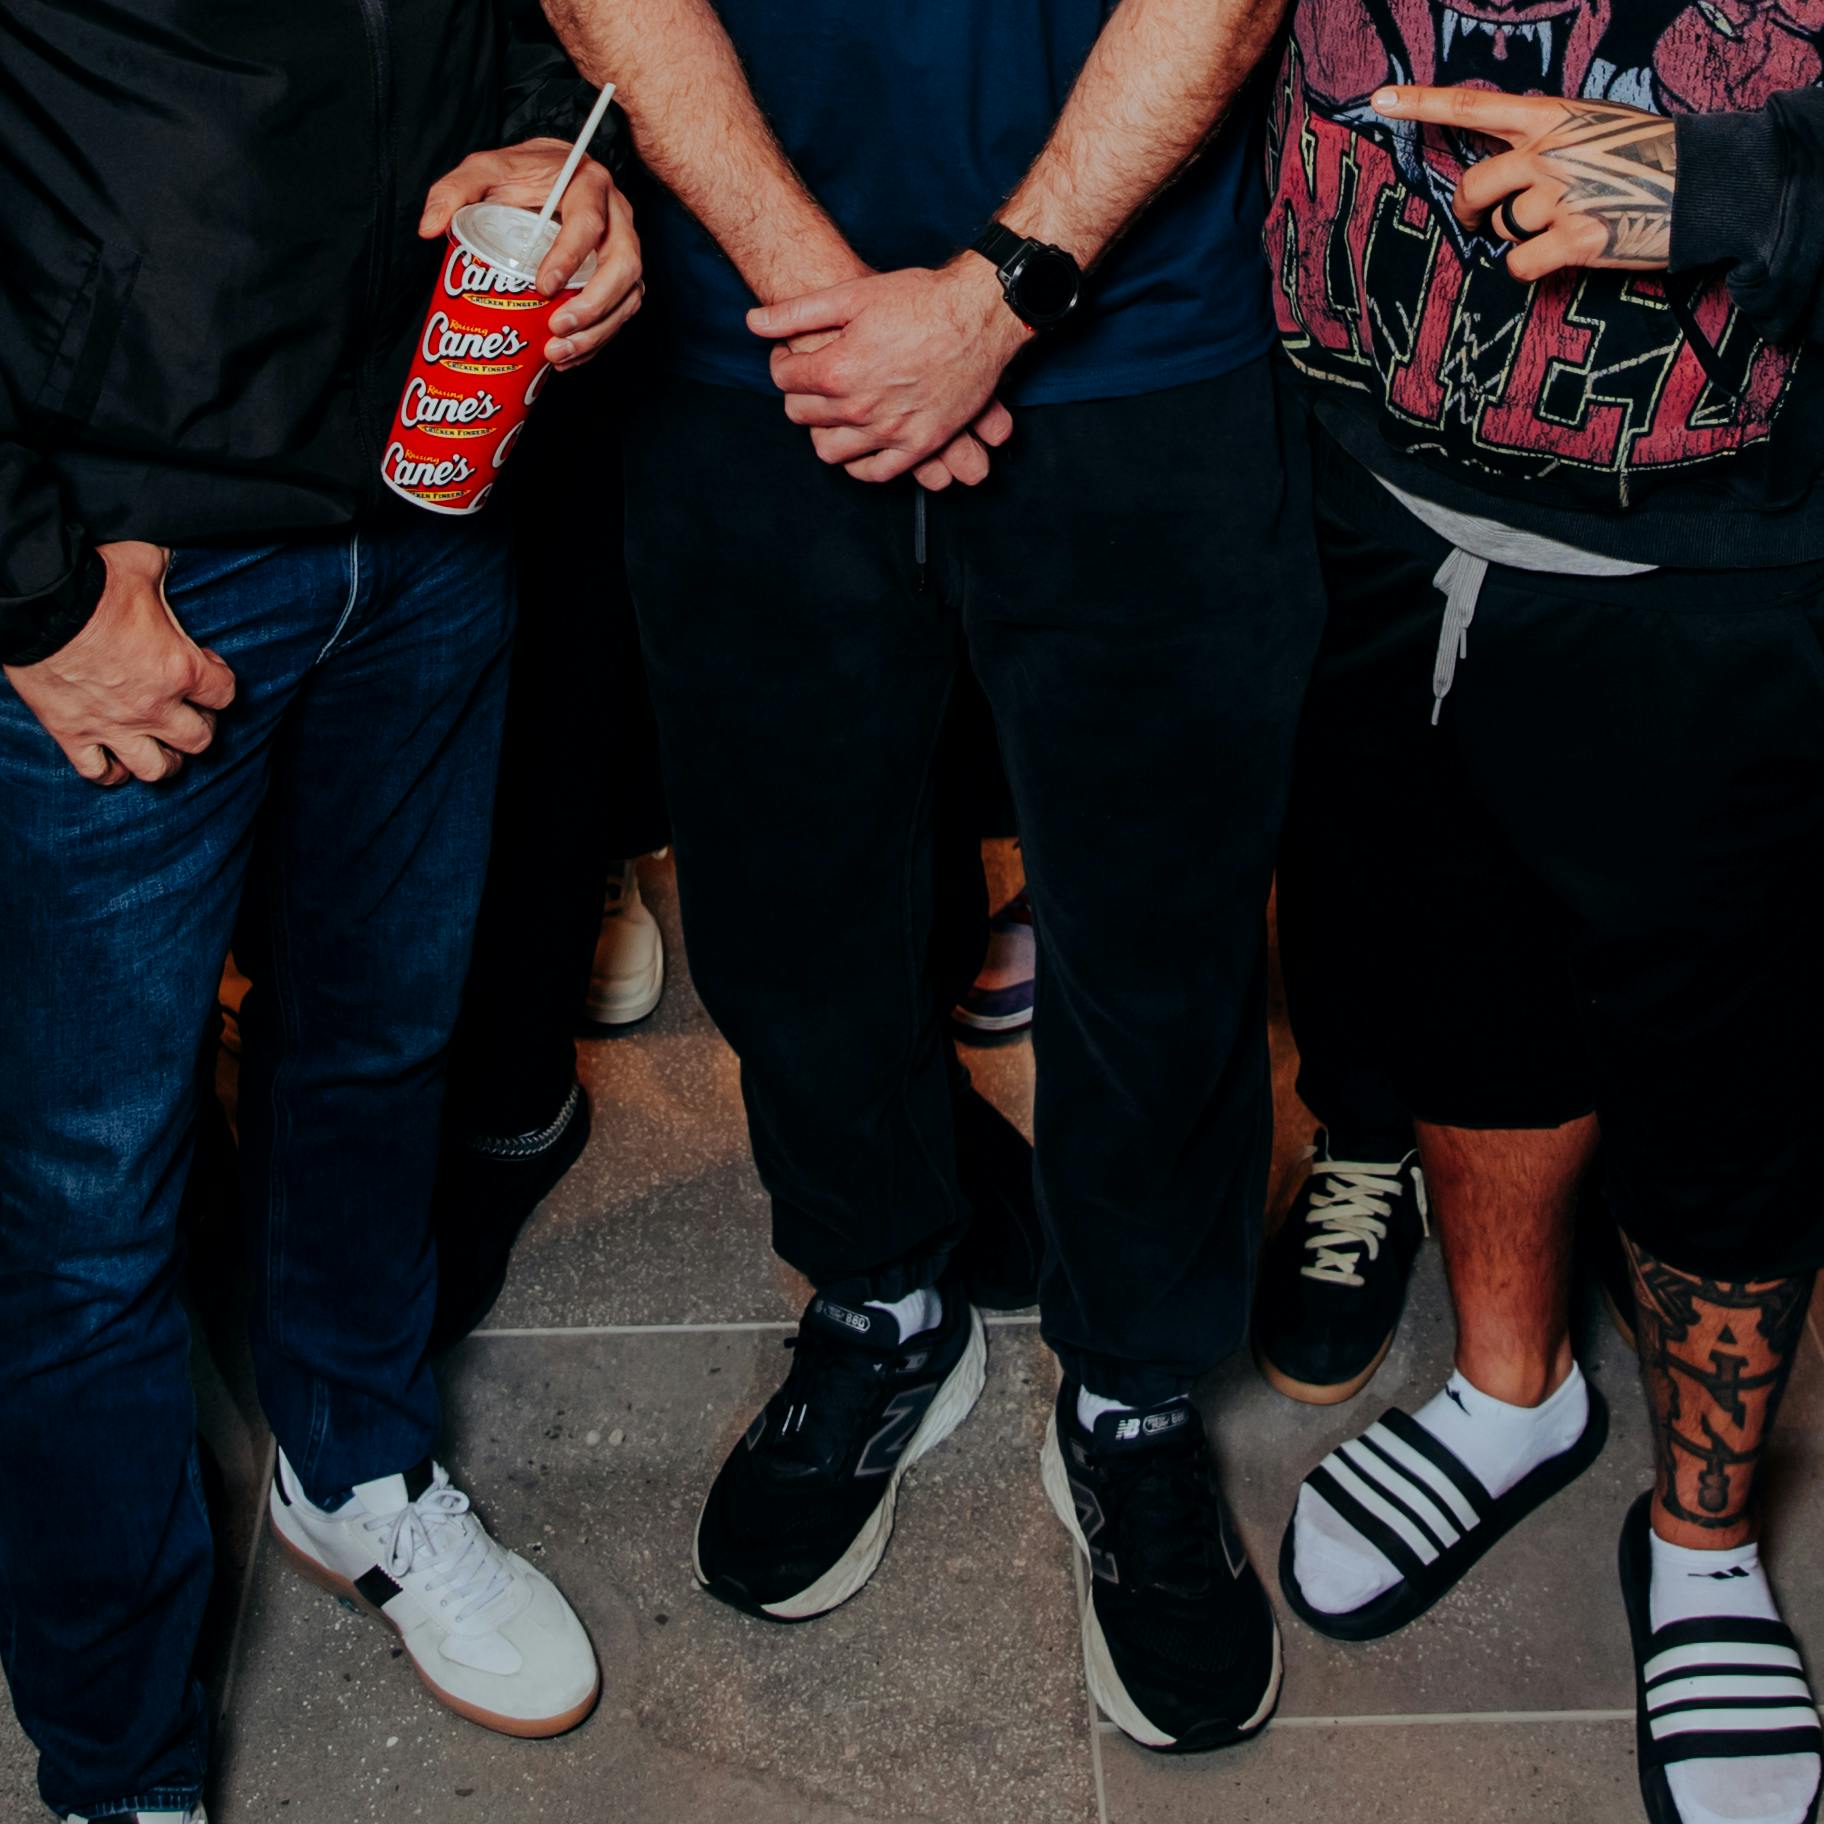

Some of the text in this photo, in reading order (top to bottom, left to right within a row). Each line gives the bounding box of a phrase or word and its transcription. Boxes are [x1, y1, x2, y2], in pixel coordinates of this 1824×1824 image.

[422, 310, 528, 362] Cane's
[449, 318, 489, 336] Raising
[400, 376, 502, 427] Cane's
[381, 441, 476, 487] Cane's
